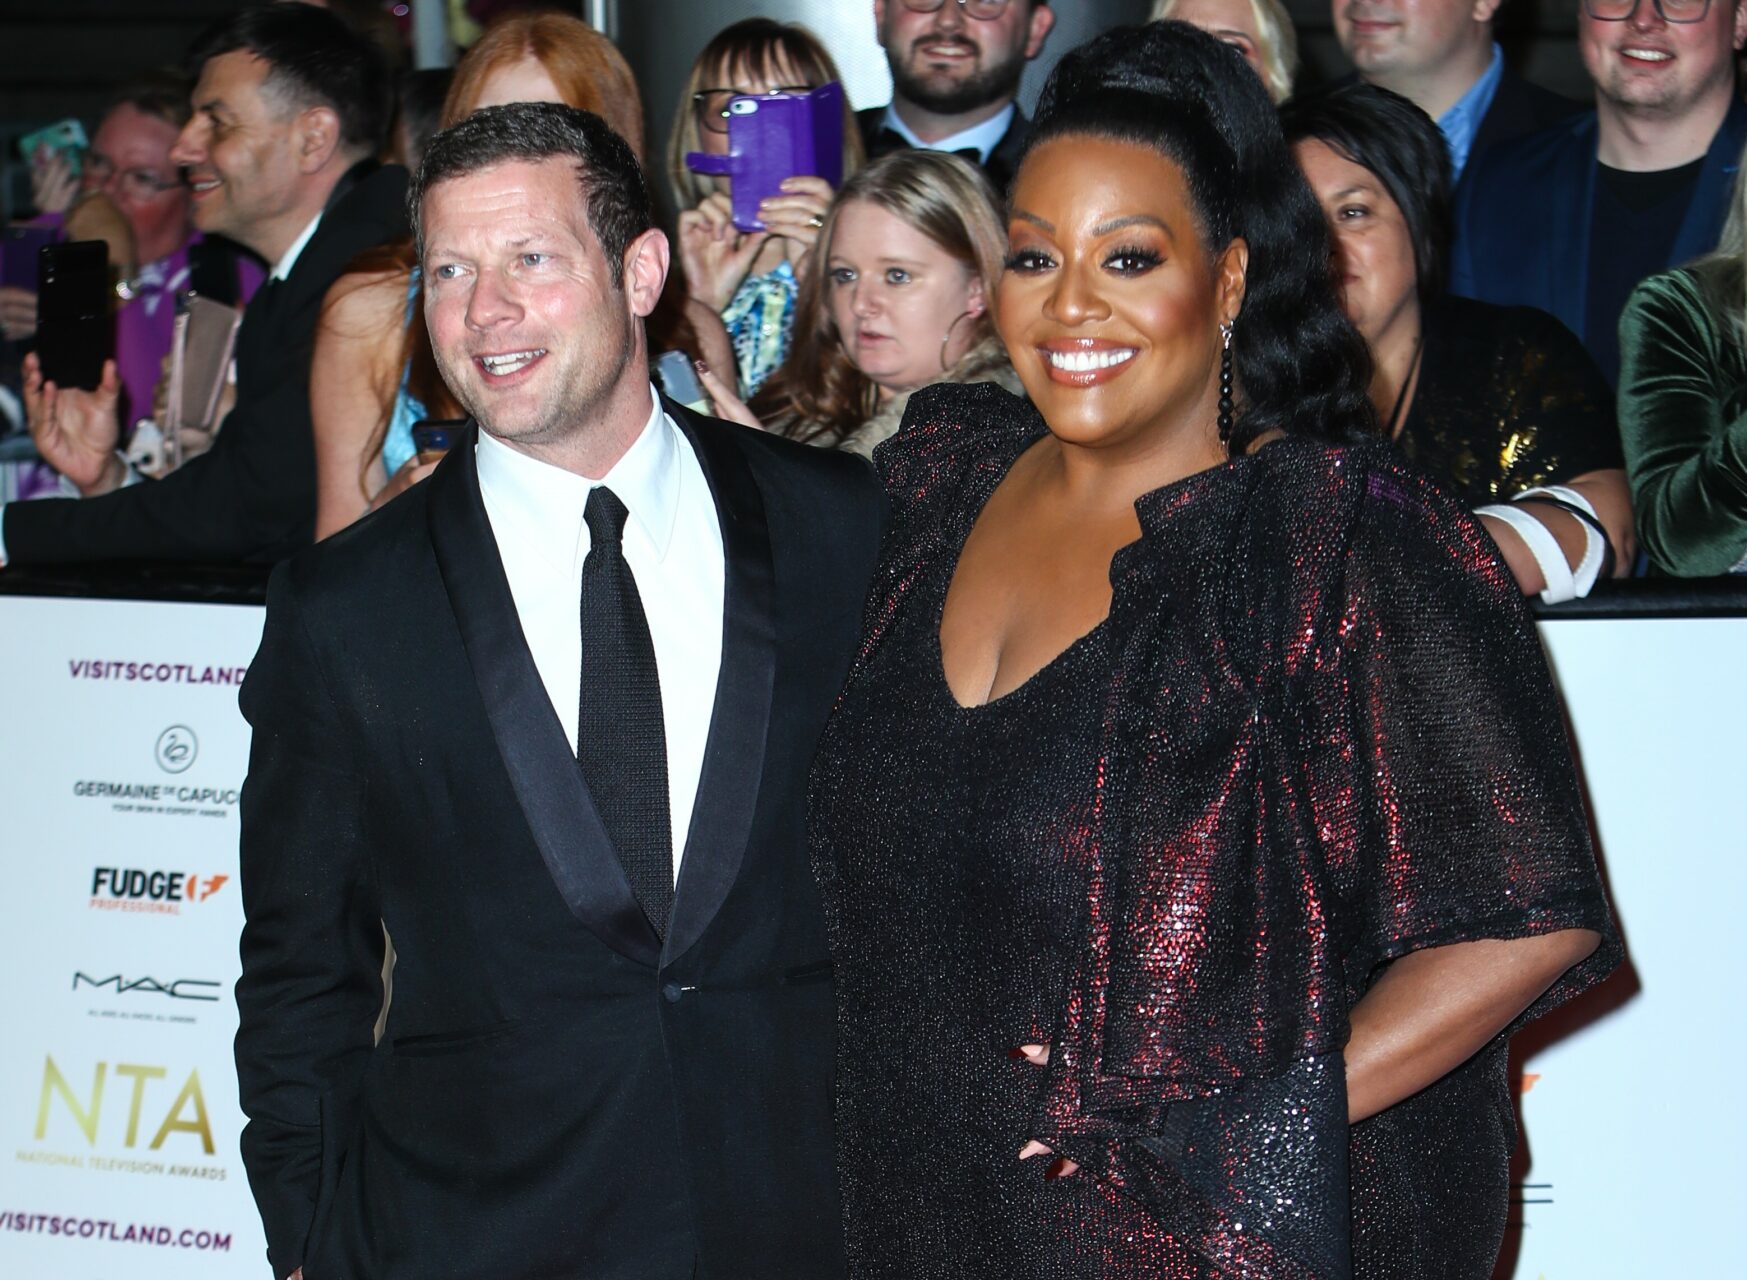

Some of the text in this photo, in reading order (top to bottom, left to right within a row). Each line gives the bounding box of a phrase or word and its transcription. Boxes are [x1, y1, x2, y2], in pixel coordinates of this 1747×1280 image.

[73, 780, 160, 801] GERMAINE
[177, 787, 240, 805] CAPUC
[92, 867, 184, 901] FUDGE
[89, 898, 182, 916] PROFESSIONAL
[34, 1053, 215, 1155] NTA
[15, 1150, 228, 1182] NATIONAL TELEVISION AWARDS
